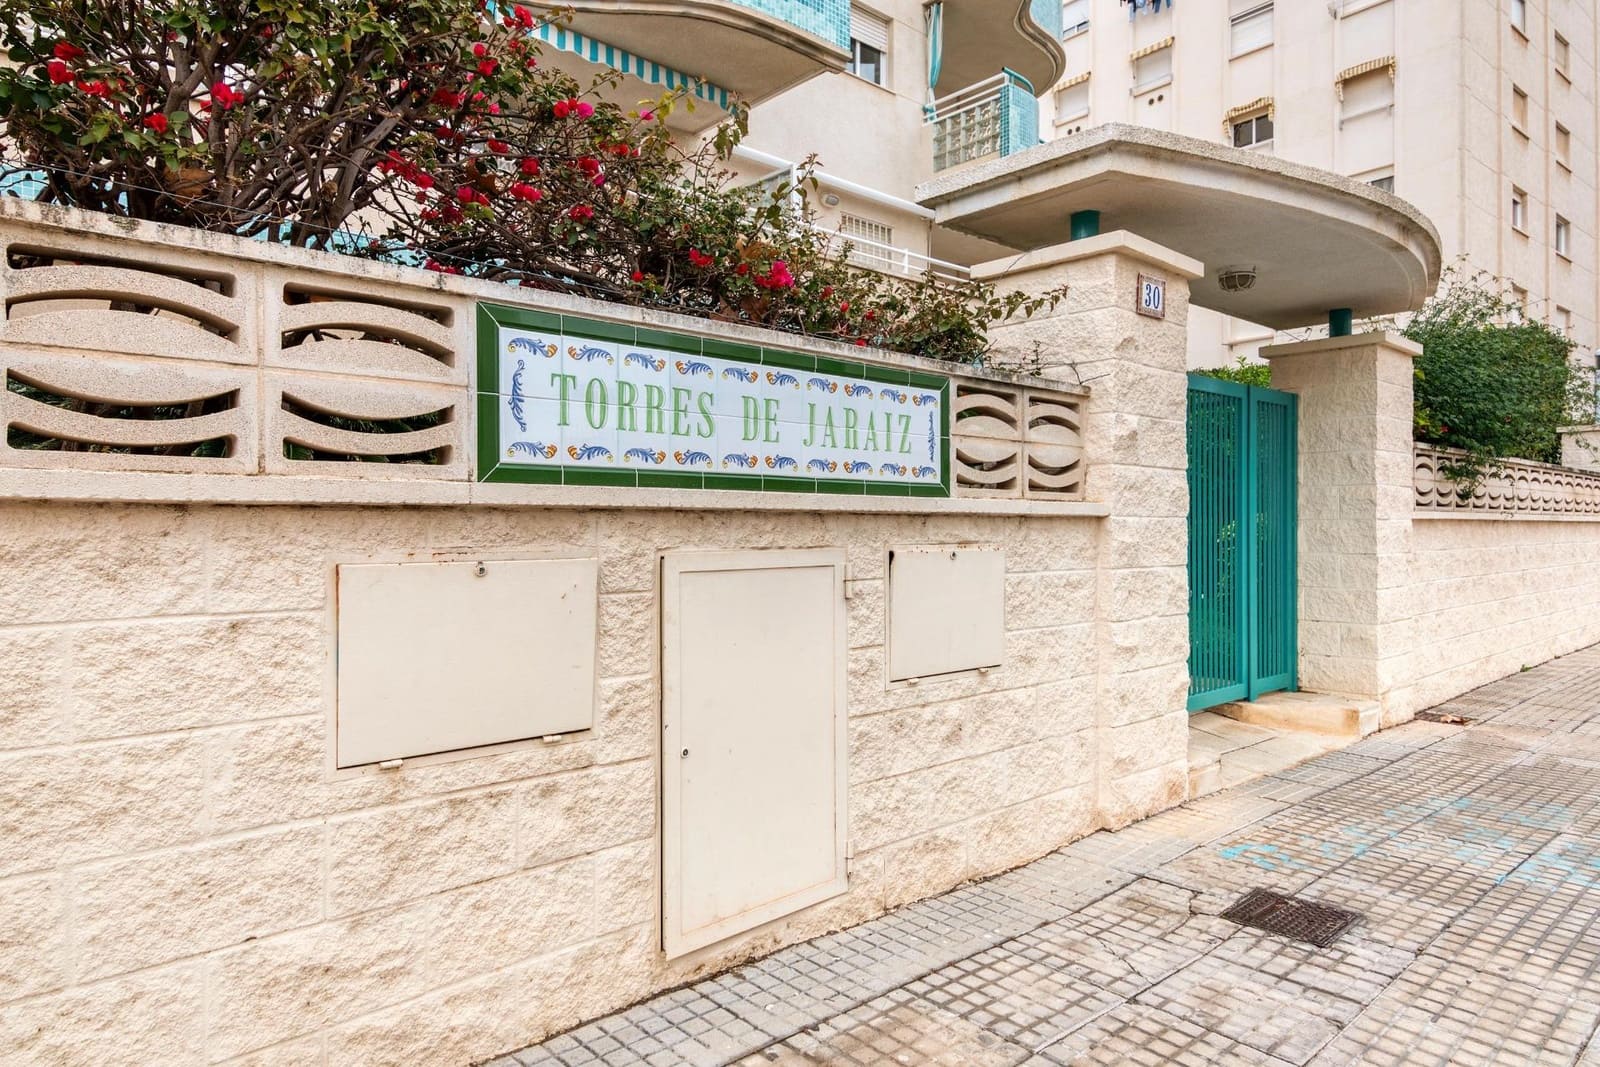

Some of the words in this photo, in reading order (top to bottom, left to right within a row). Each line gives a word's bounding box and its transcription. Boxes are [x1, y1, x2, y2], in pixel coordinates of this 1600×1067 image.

[1145, 283, 1160, 309] 30
[551, 373, 715, 438] TORRES
[741, 395, 780, 443] DE
[803, 402, 912, 454] JARAIZ
